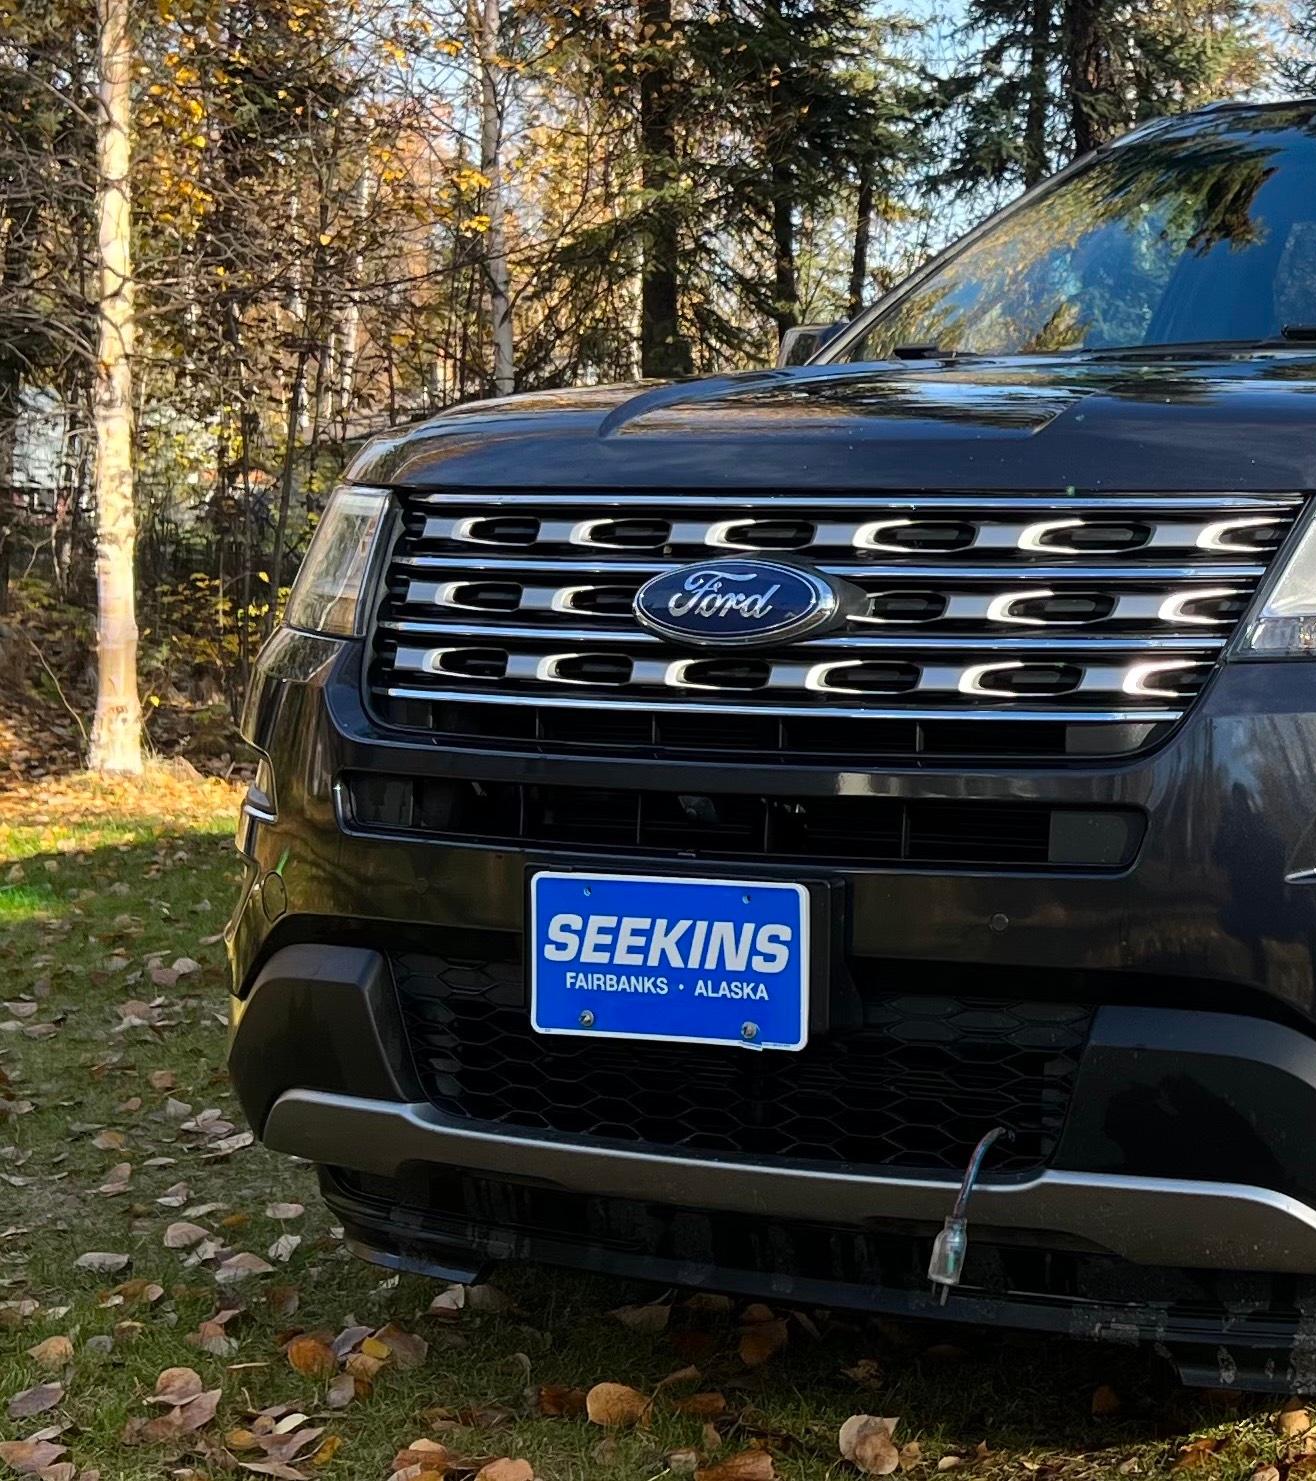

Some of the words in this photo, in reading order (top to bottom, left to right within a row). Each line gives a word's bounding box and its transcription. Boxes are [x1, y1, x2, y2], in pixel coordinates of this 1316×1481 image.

[668, 570, 781, 619] Ford
[543, 913, 793, 974] SEEKINS
[565, 971, 669, 995] FAIRBANKS
[694, 979, 769, 1001] ALASKA
